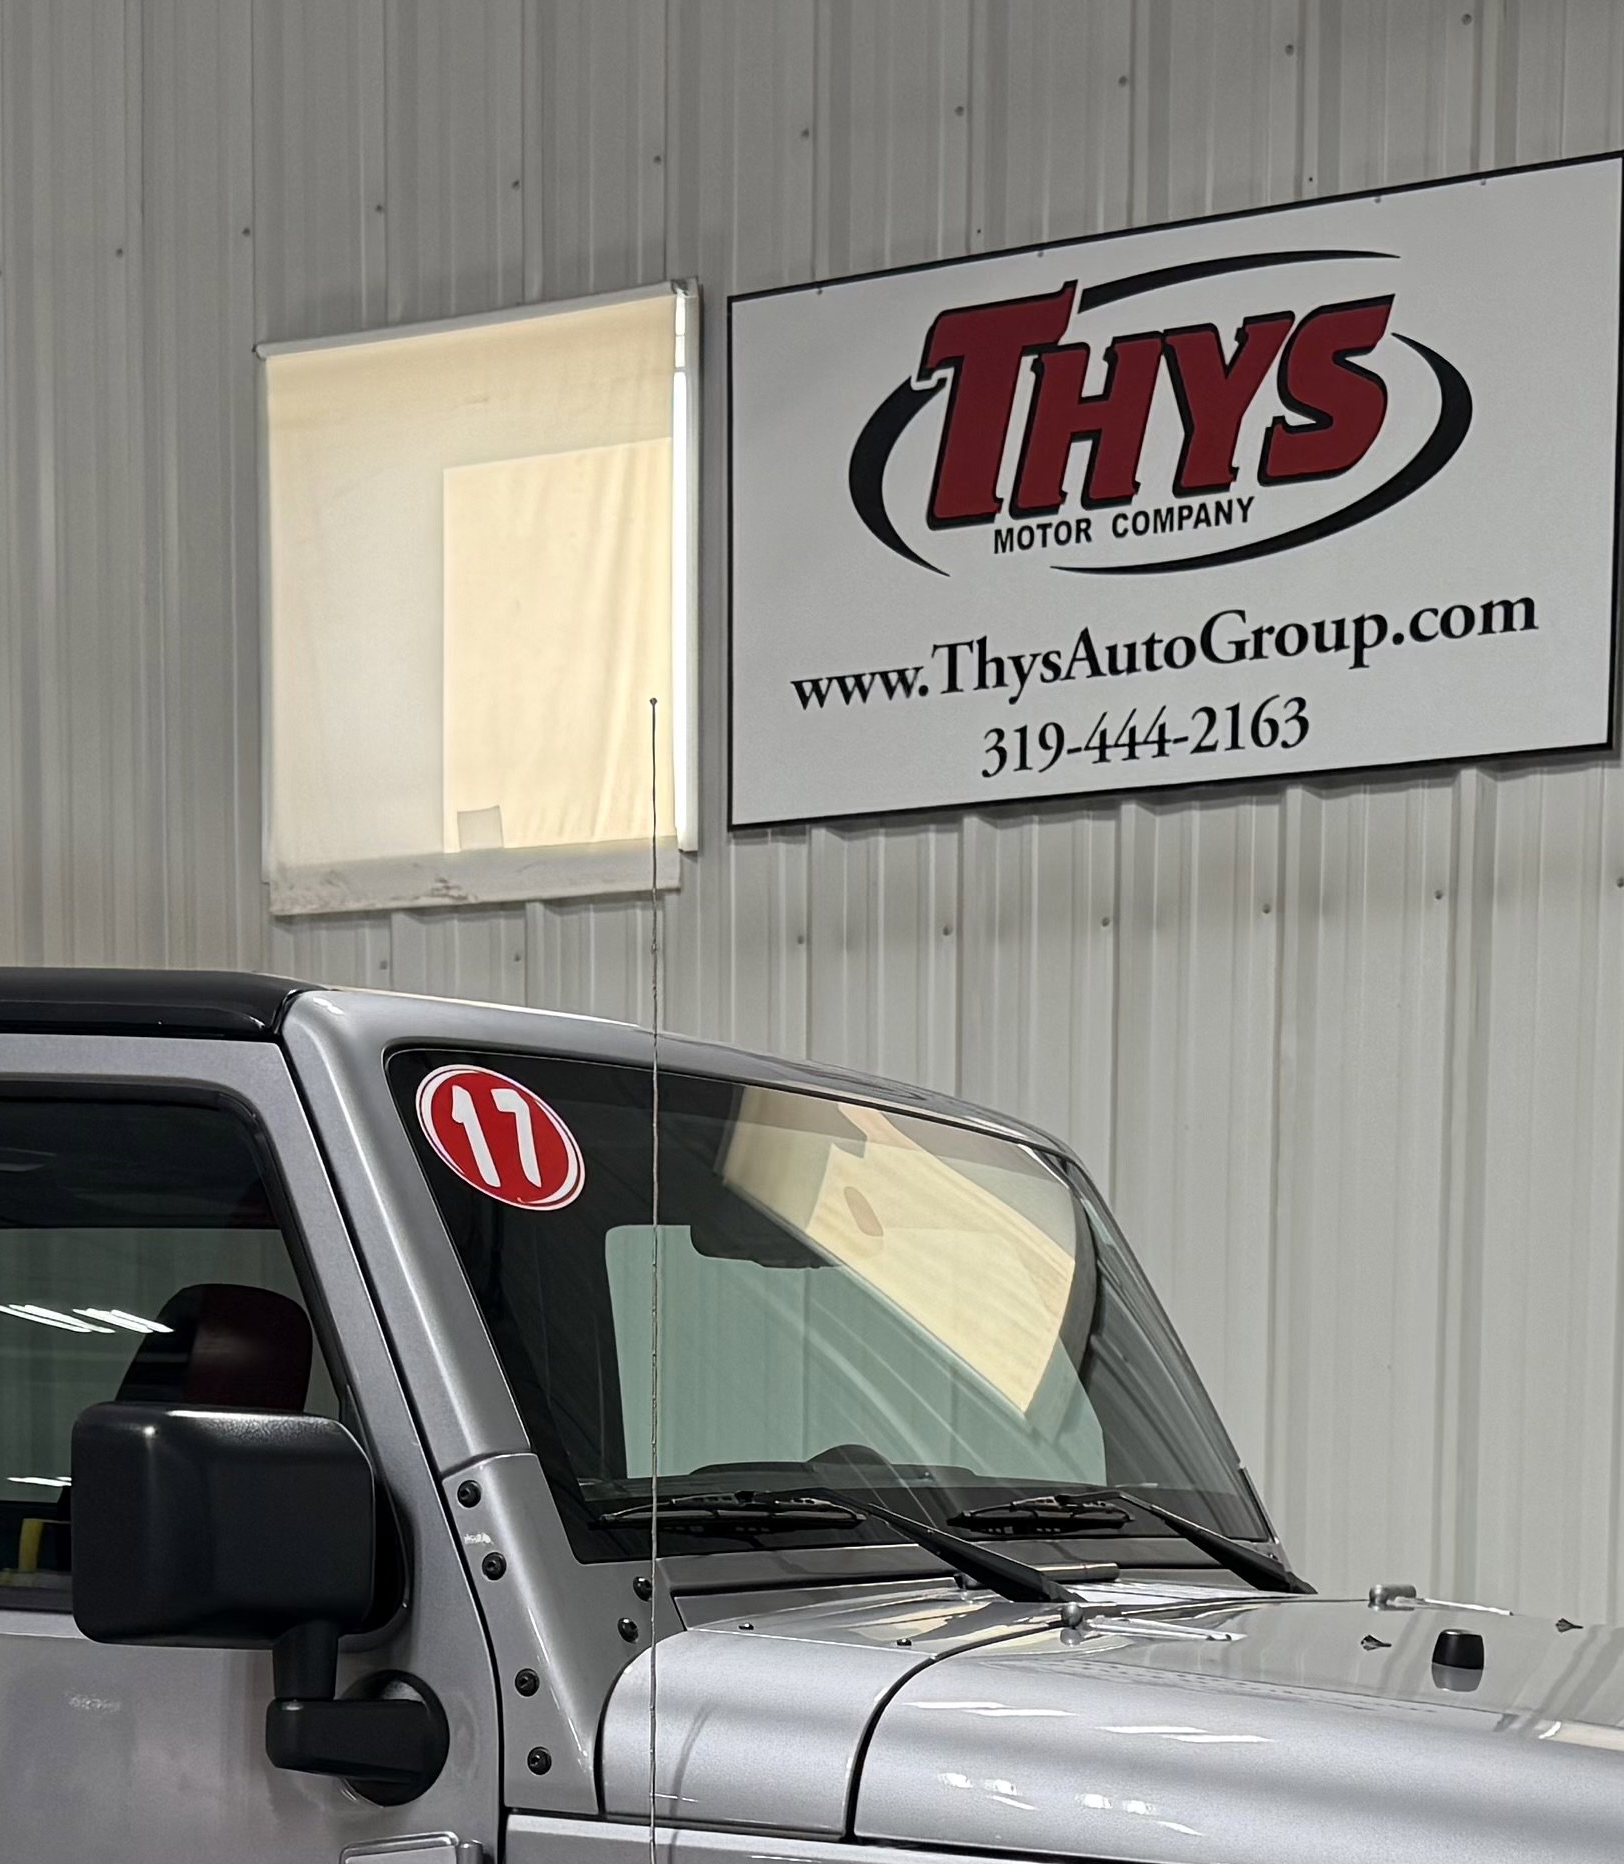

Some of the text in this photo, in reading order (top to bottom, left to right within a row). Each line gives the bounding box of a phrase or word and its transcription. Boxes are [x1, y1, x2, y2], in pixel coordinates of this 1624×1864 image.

[911, 279, 1396, 531] THYS
[992, 495, 1255, 555] MOTOR COMPANY
[791, 595, 1539, 711] www.ThysAutoGroup.com
[981, 695, 1311, 779] 319-444-2163
[451, 1084, 542, 1188] 17
